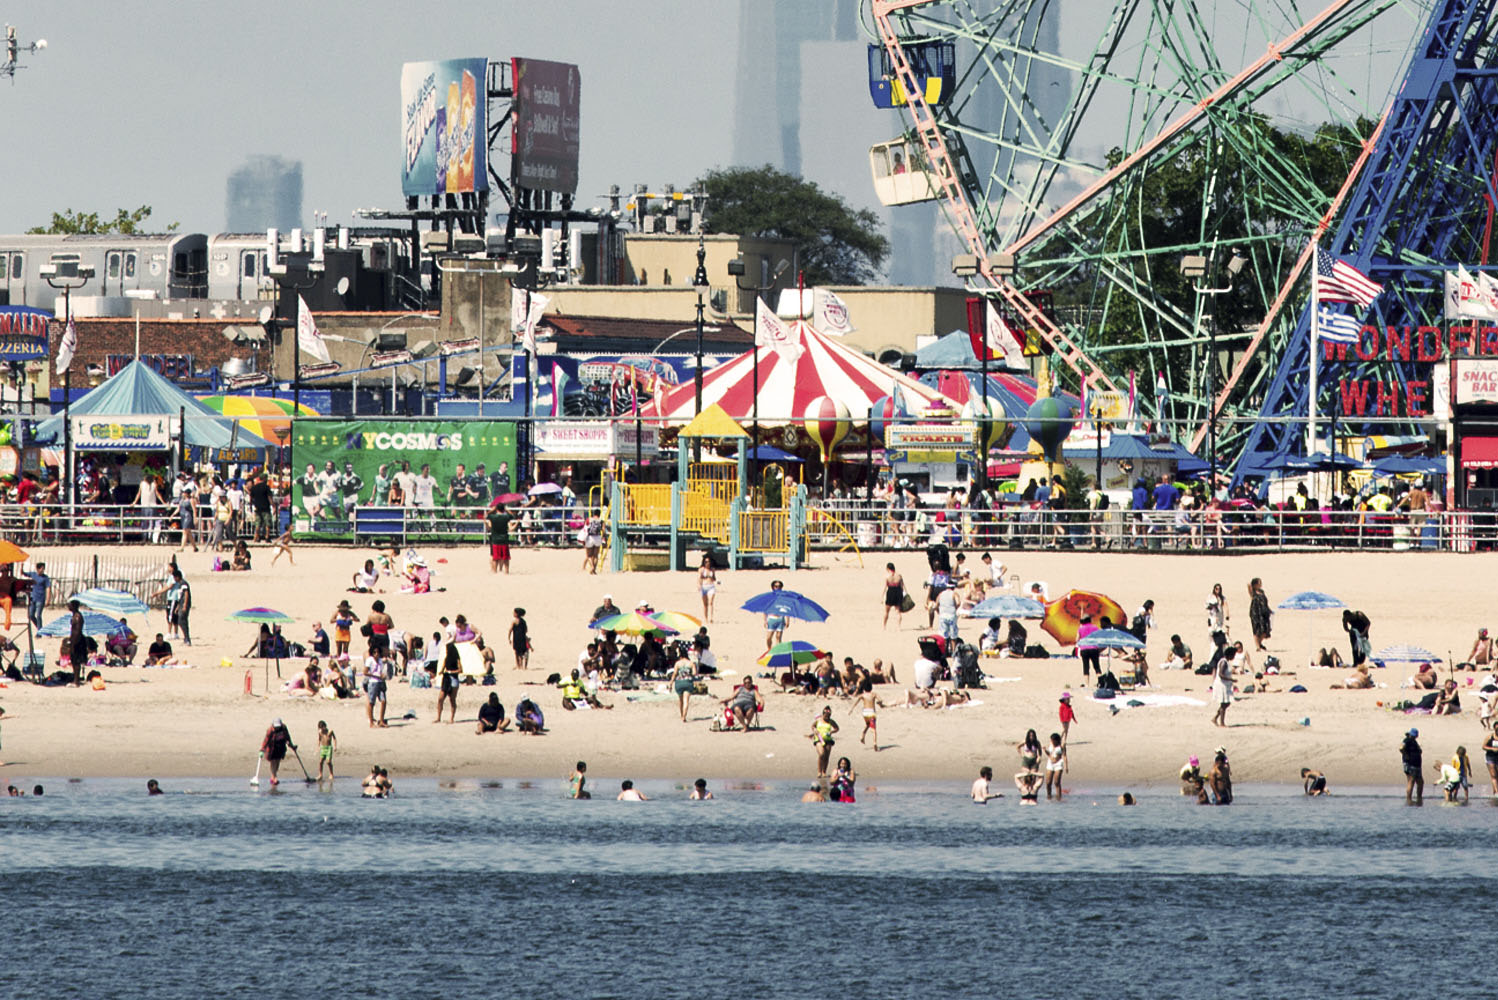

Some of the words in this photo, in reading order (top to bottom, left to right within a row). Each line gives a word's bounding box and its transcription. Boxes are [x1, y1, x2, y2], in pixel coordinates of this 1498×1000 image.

[1472, 382, 1498, 393] BAR
[1340, 379, 1428, 417] WHE
[552, 428, 578, 440] SWEET
[579, 429, 608, 440] SHOPPE
